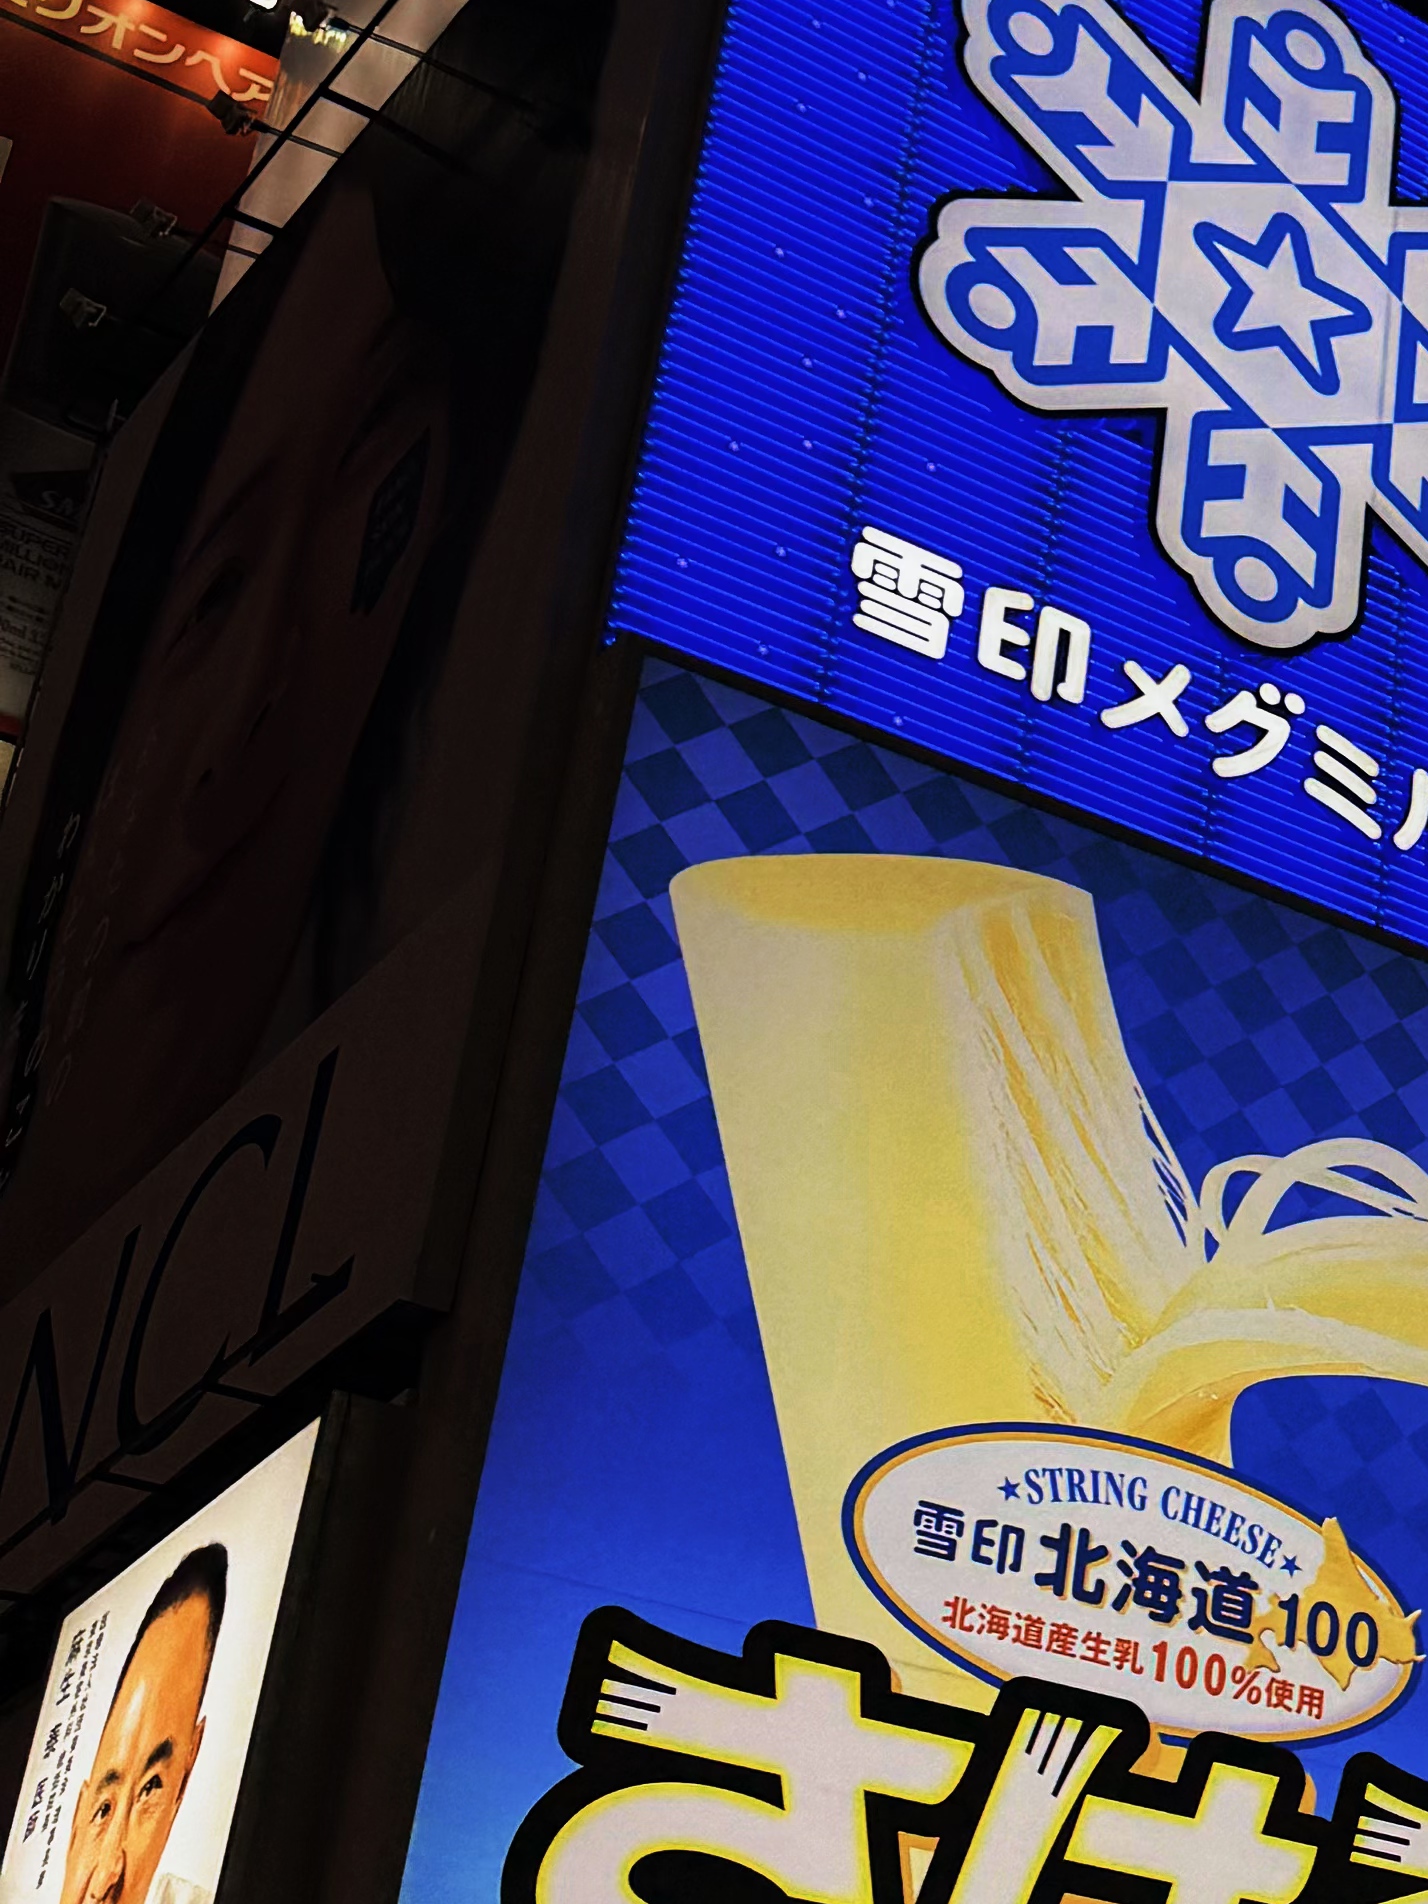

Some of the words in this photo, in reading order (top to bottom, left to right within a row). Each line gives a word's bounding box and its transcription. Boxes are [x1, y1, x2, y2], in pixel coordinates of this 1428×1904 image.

[1024, 1466, 1149, 1512] STRING
[1160, 1484, 1278, 1569] CHEESE
[943, 1596, 1325, 1720] 北海道産生乳100%使用
